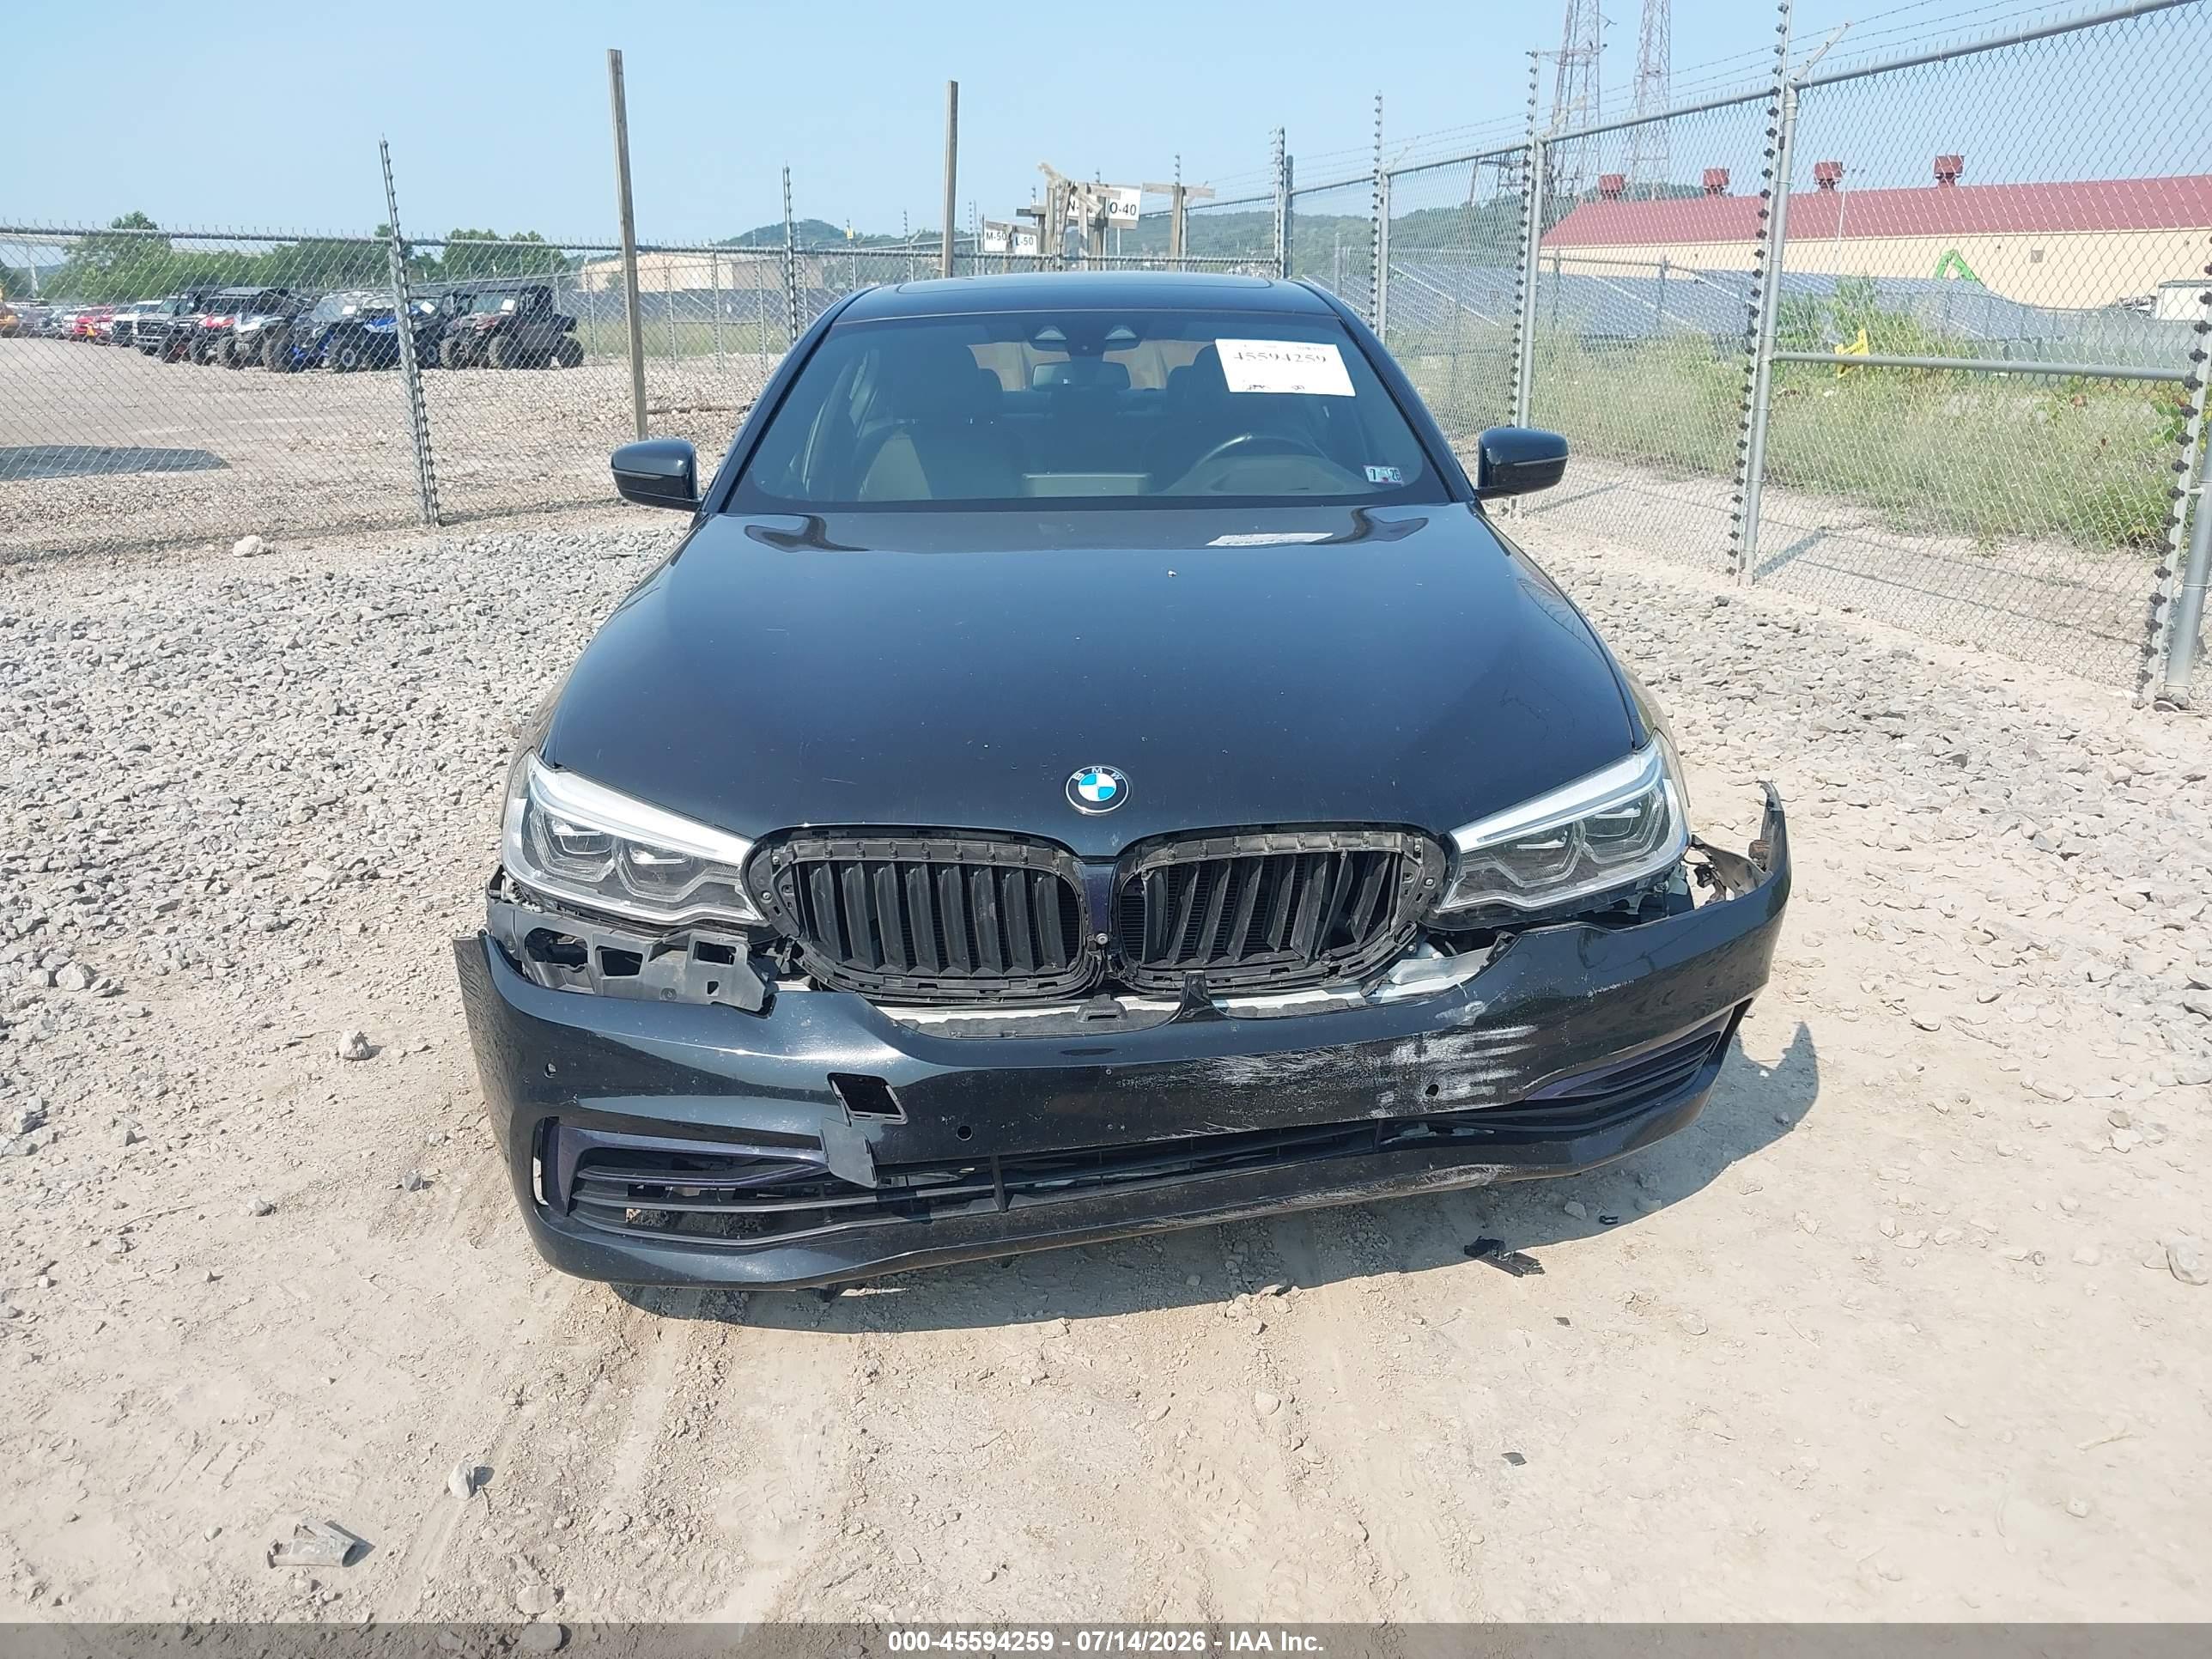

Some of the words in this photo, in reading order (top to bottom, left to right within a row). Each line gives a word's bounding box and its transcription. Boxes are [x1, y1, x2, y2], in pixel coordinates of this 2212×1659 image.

[986, 231, 1007, 241] M-50
[1015, 235, 1034, 246] L-50
[1071, 767, 1123, 781] BMW
